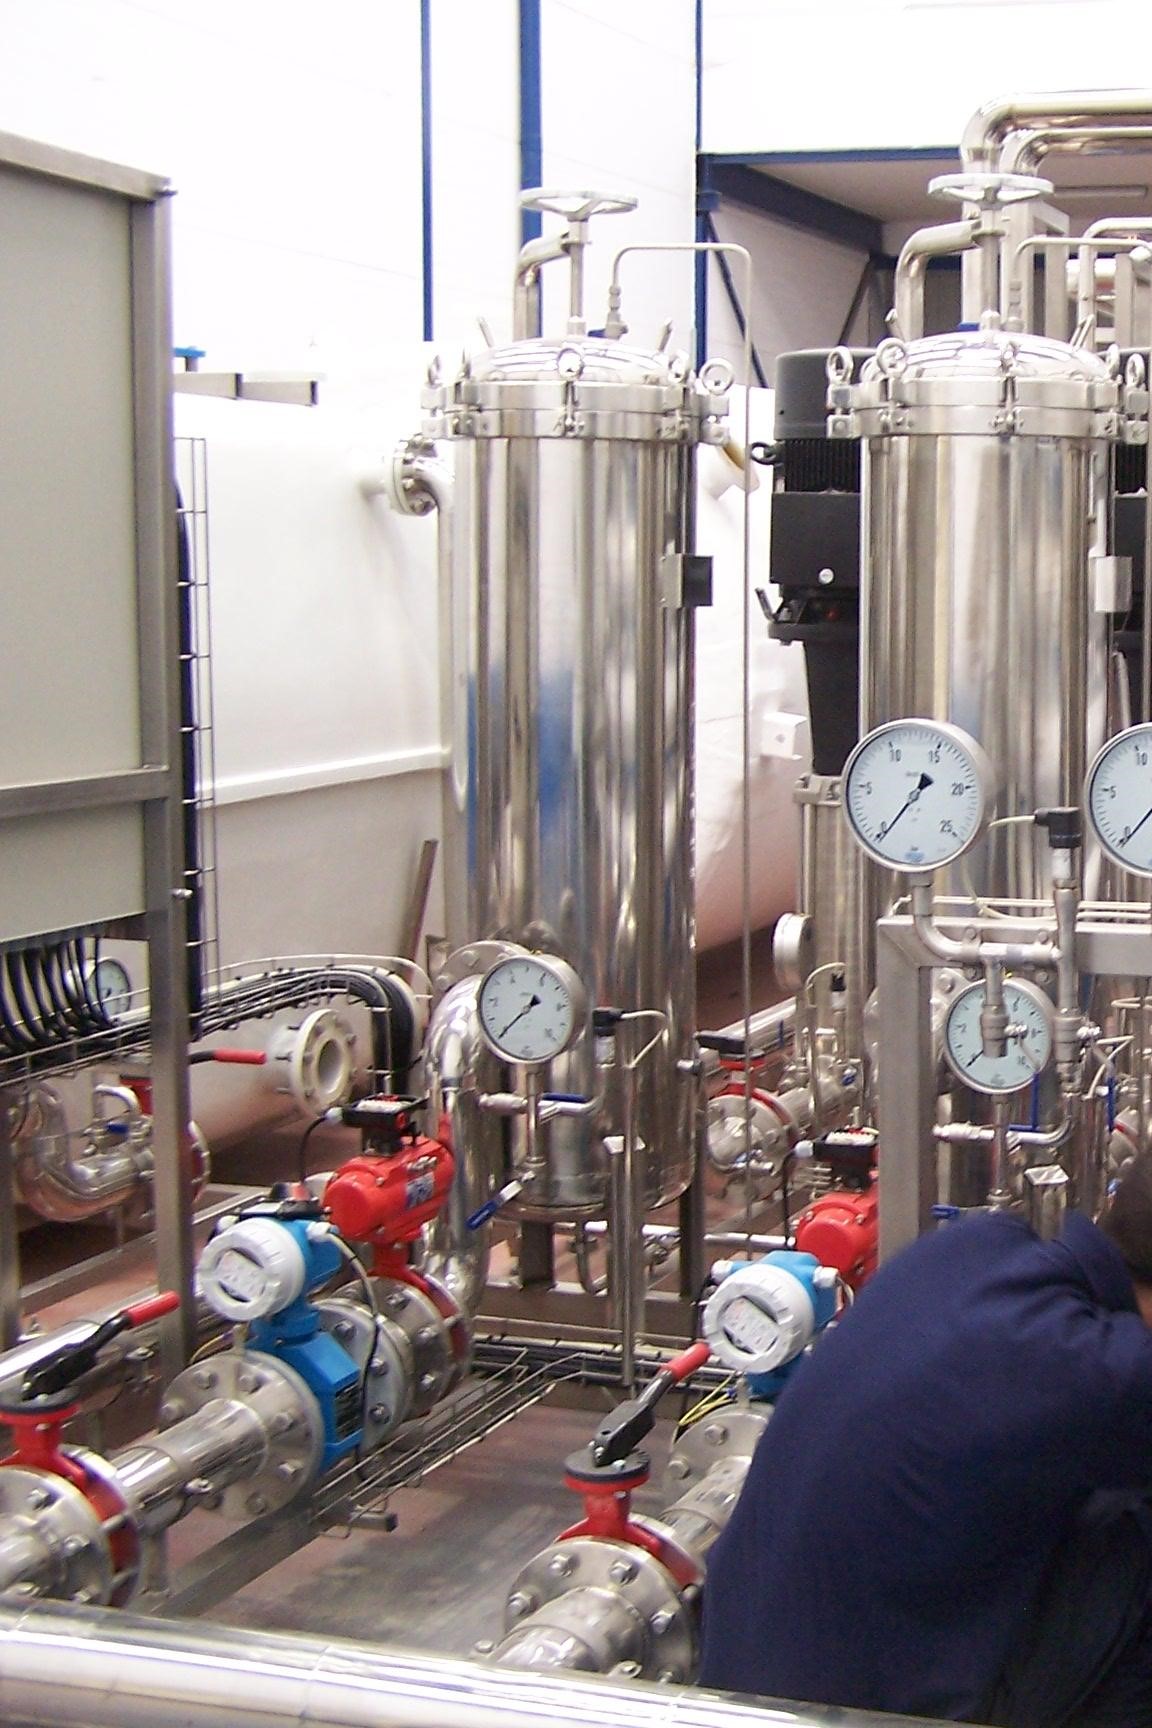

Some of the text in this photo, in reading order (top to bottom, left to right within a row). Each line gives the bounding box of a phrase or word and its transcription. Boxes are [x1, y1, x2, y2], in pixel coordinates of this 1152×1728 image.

[889, 750, 902, 762] 10
[928, 750, 941, 763] 15
[1136, 752, 1148, 766] 10
[866, 782, 872, 795] 5
[951, 783, 965, 796] 20
[1110, 786, 1117, 799] 5
[940, 820, 952, 833] 25
